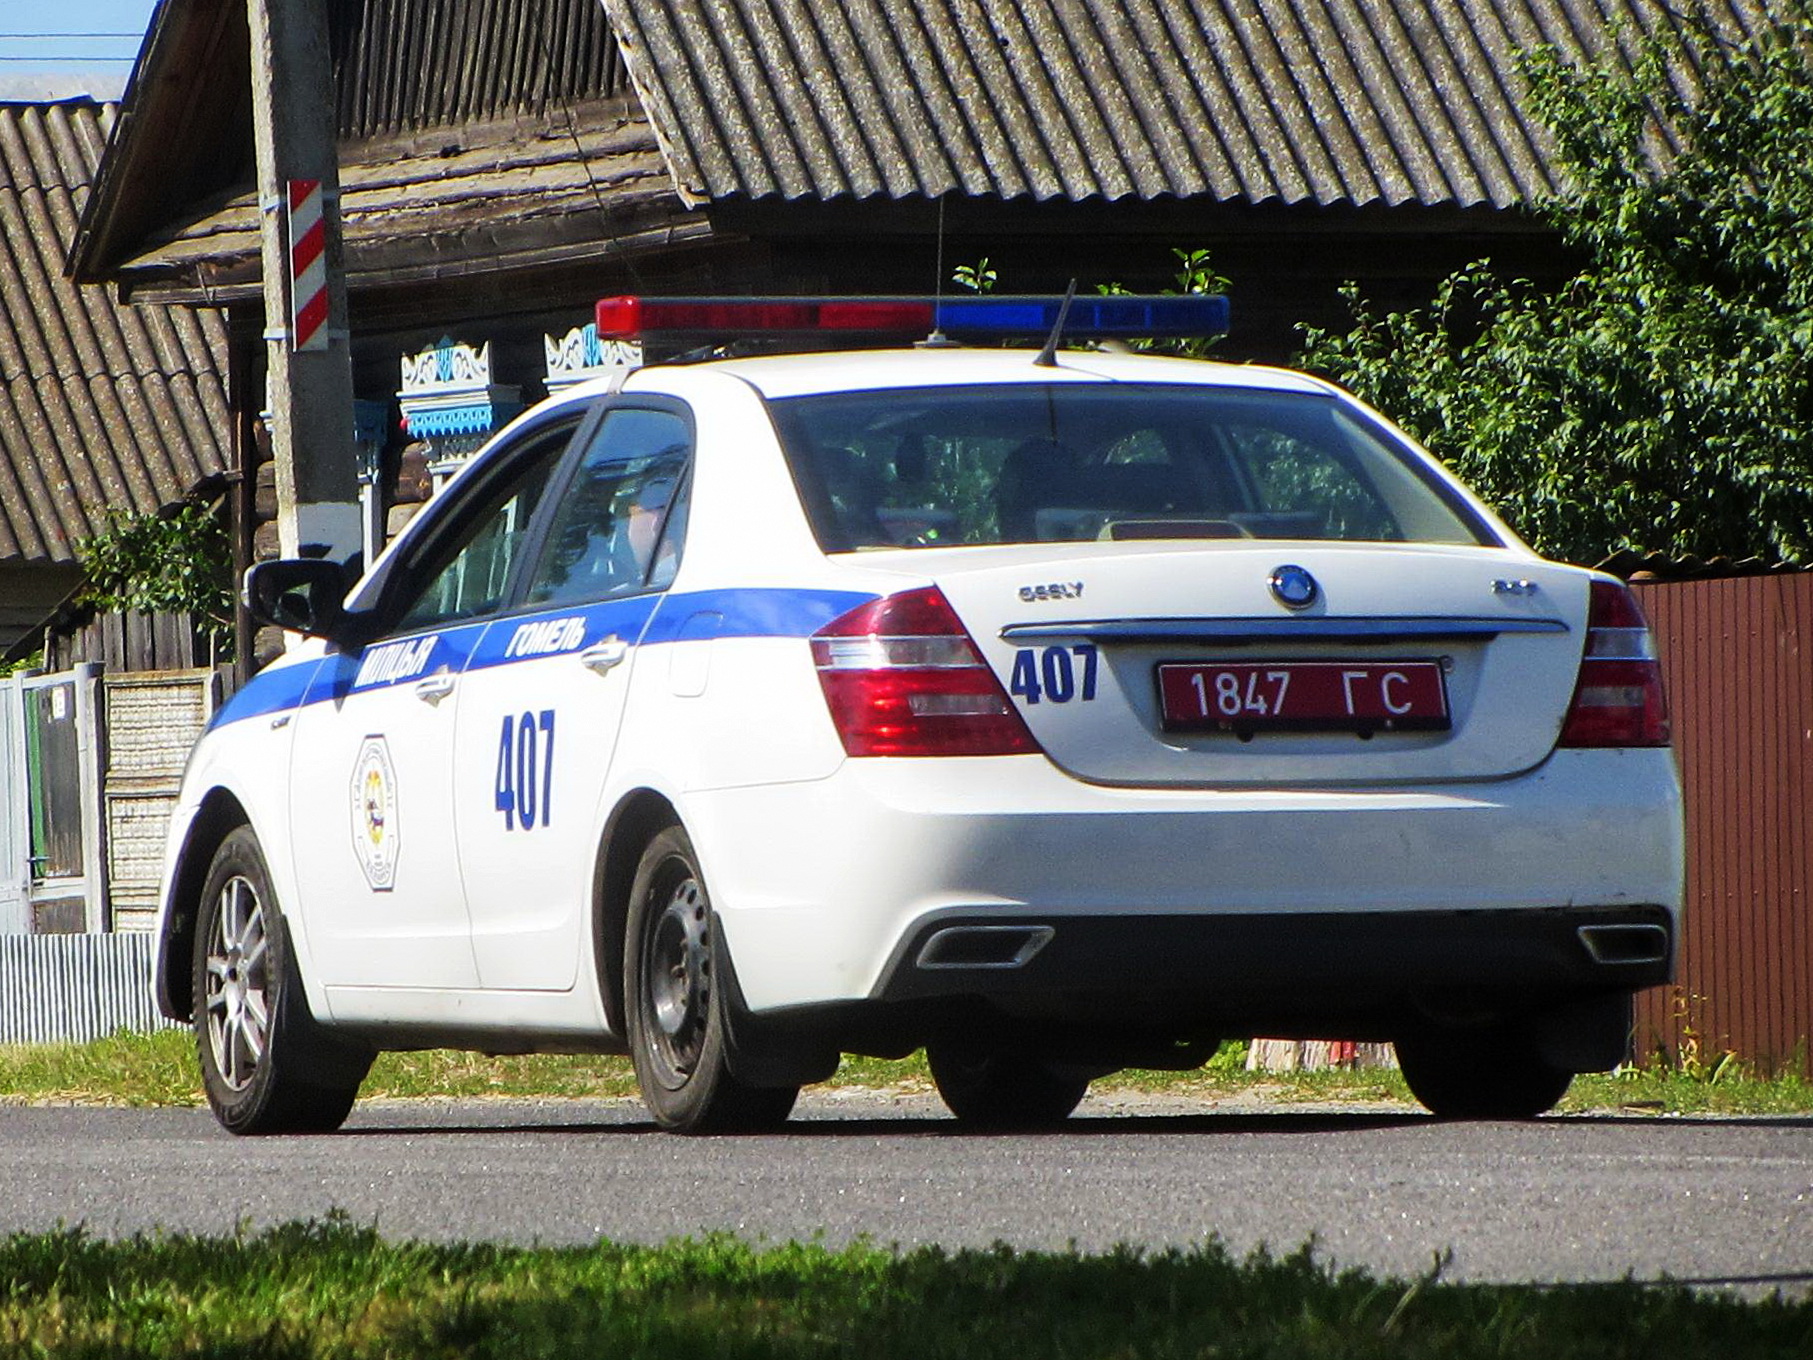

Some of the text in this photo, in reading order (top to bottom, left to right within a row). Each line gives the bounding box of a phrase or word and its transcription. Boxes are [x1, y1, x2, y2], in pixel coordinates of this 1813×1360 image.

[1019, 581, 1084, 602] GEELY
[504, 616, 587, 658] ГОМЕЛЬ
[1011, 644, 1098, 704] 407
[1191, 670, 1291, 716] 1847
[495, 709, 556, 831] 407
